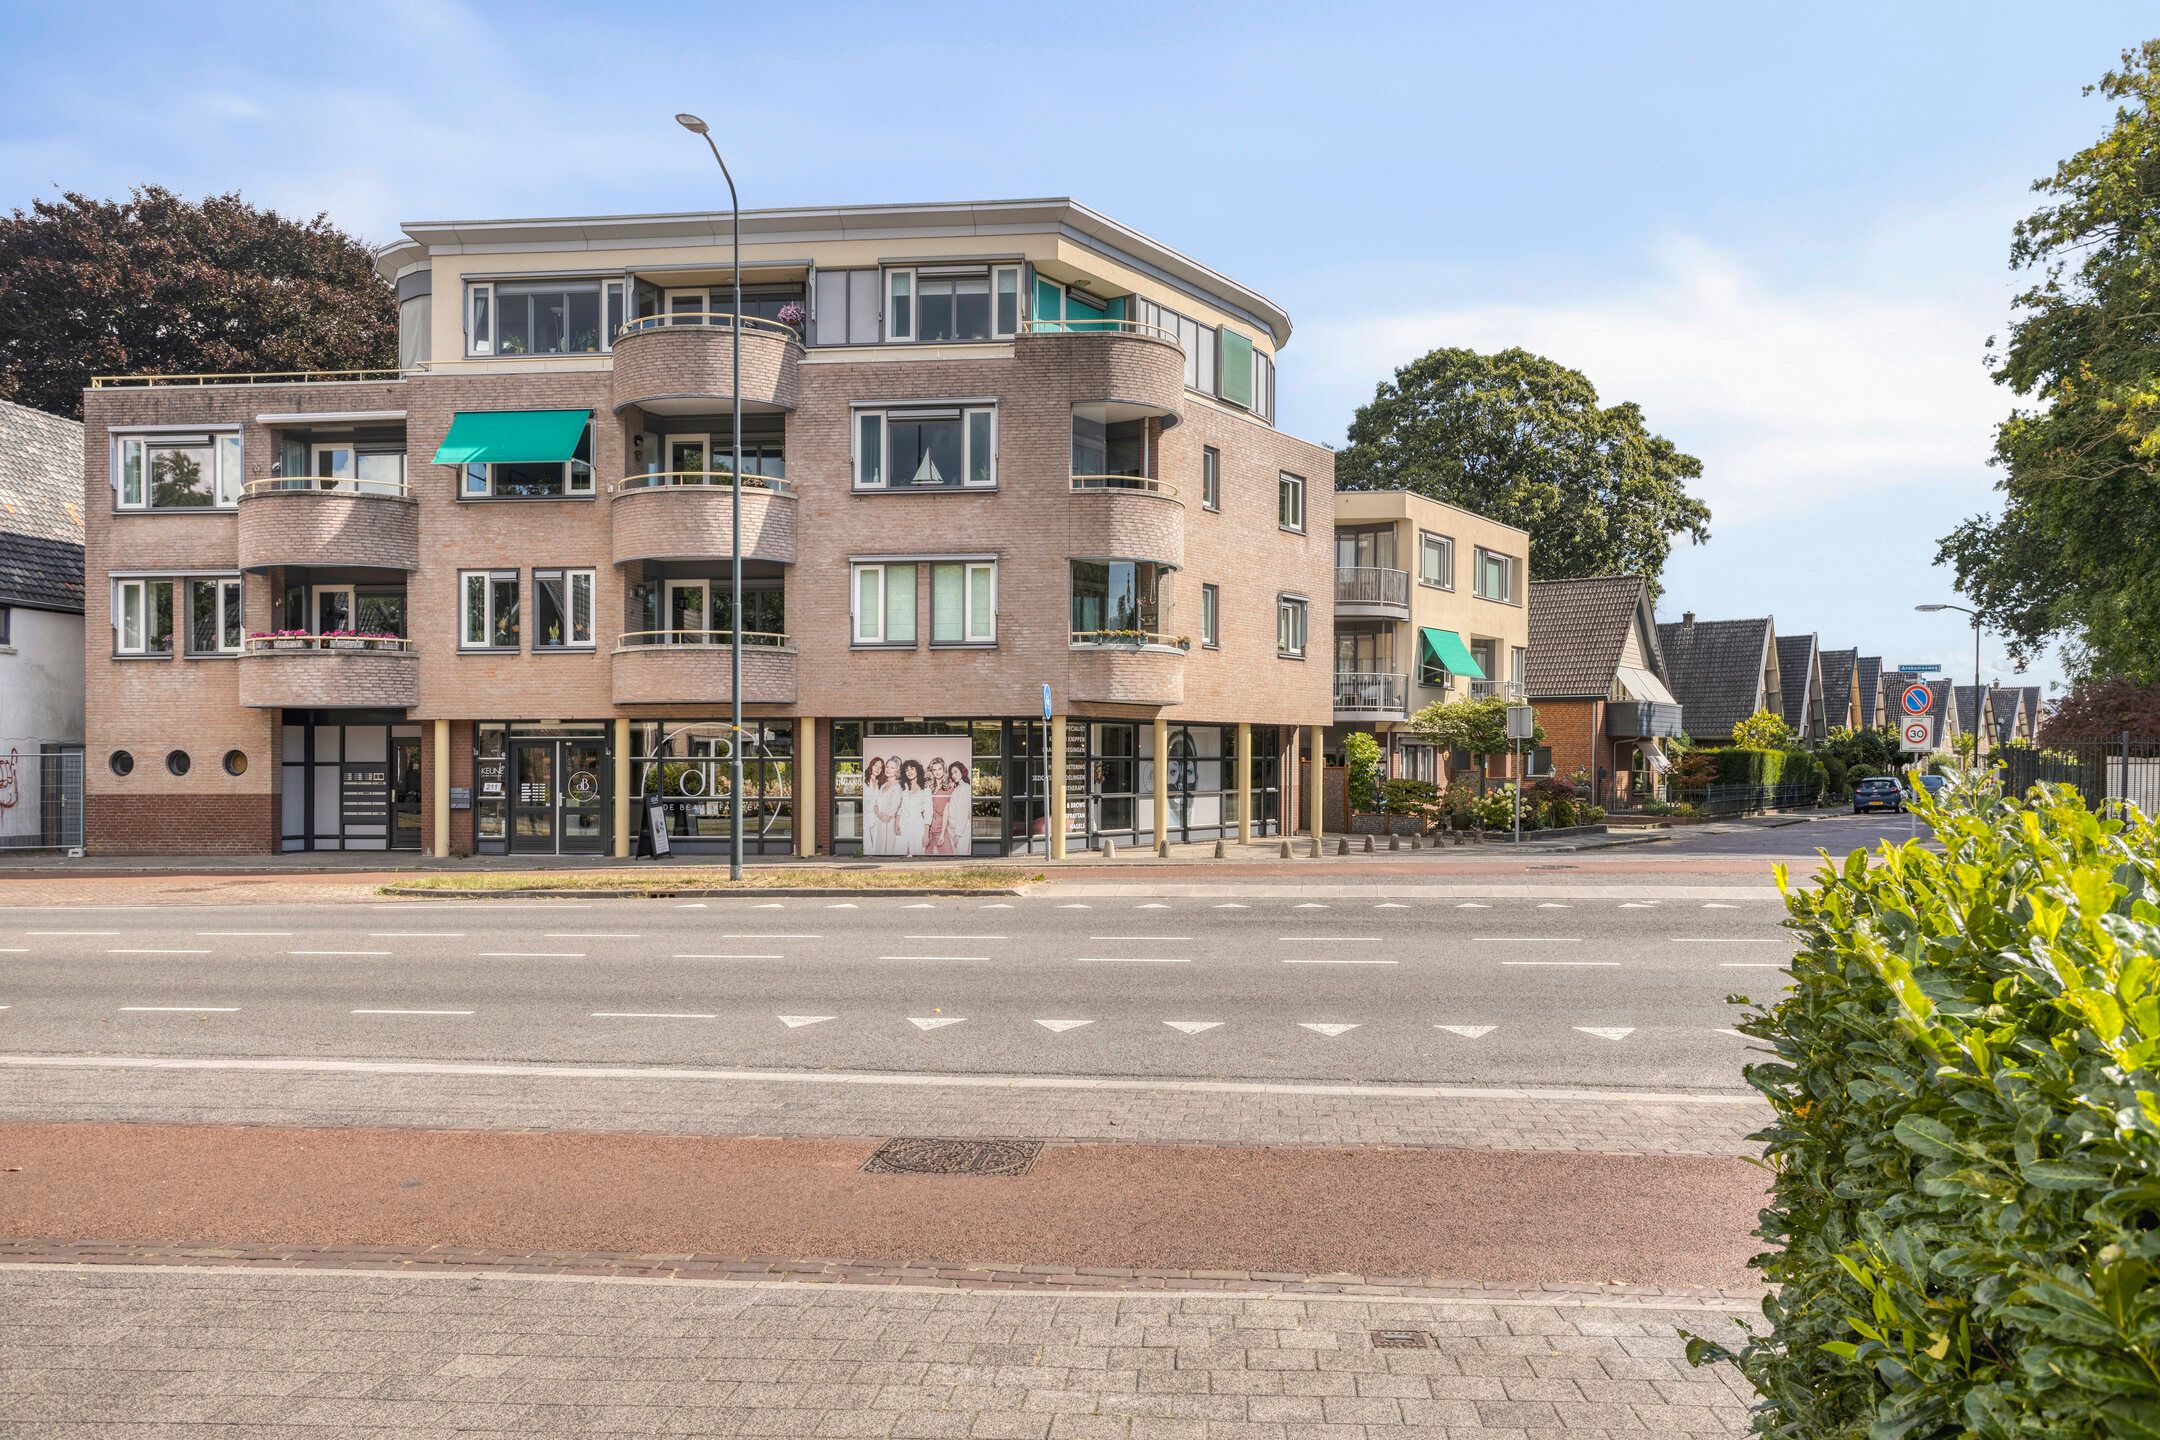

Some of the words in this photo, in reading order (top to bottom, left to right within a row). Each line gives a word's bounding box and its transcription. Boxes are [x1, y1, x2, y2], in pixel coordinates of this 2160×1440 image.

[1909, 730, 1924, 738] 30
[481, 767, 504, 775] KEUNE
[663, 803, 675, 811] DE
